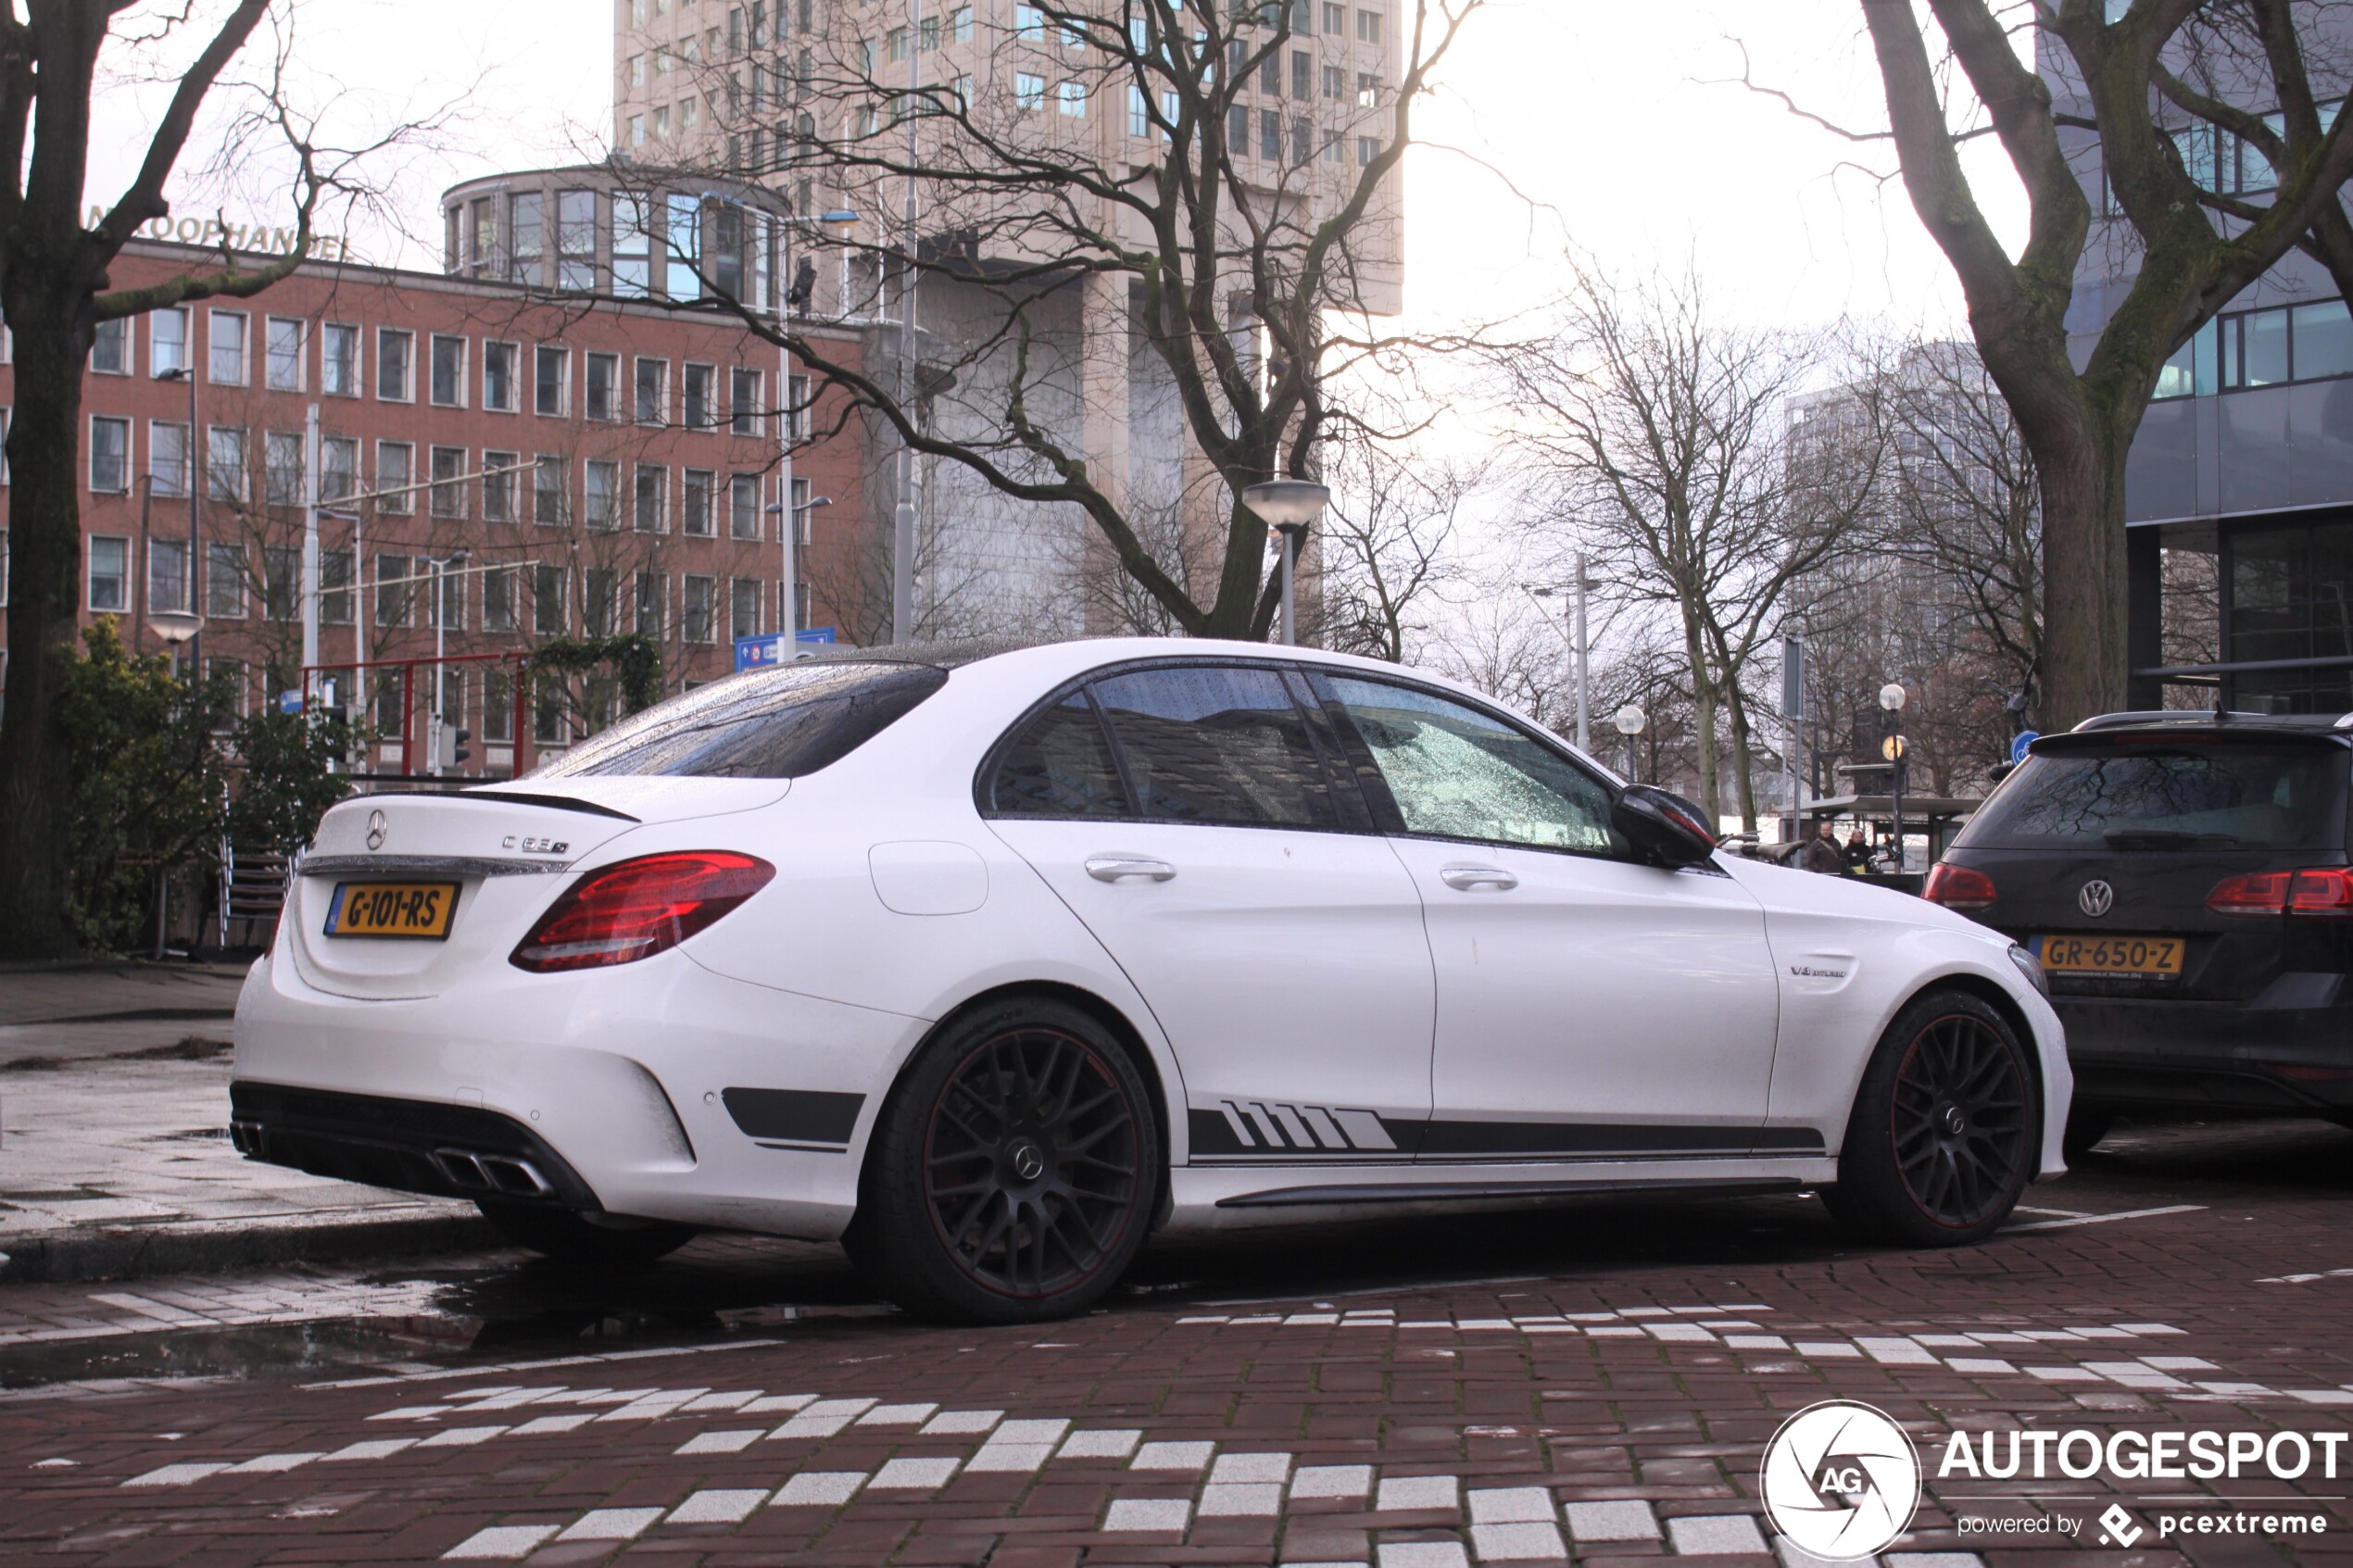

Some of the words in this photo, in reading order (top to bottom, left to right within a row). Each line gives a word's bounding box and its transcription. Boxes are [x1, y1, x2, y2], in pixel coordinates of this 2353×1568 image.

[137, 215, 356, 262] OOPHANEL
[502, 835, 516, 848] C
[347, 889, 441, 928] G-101-RS
[2048, 939, 2175, 969] GR-650-Z
